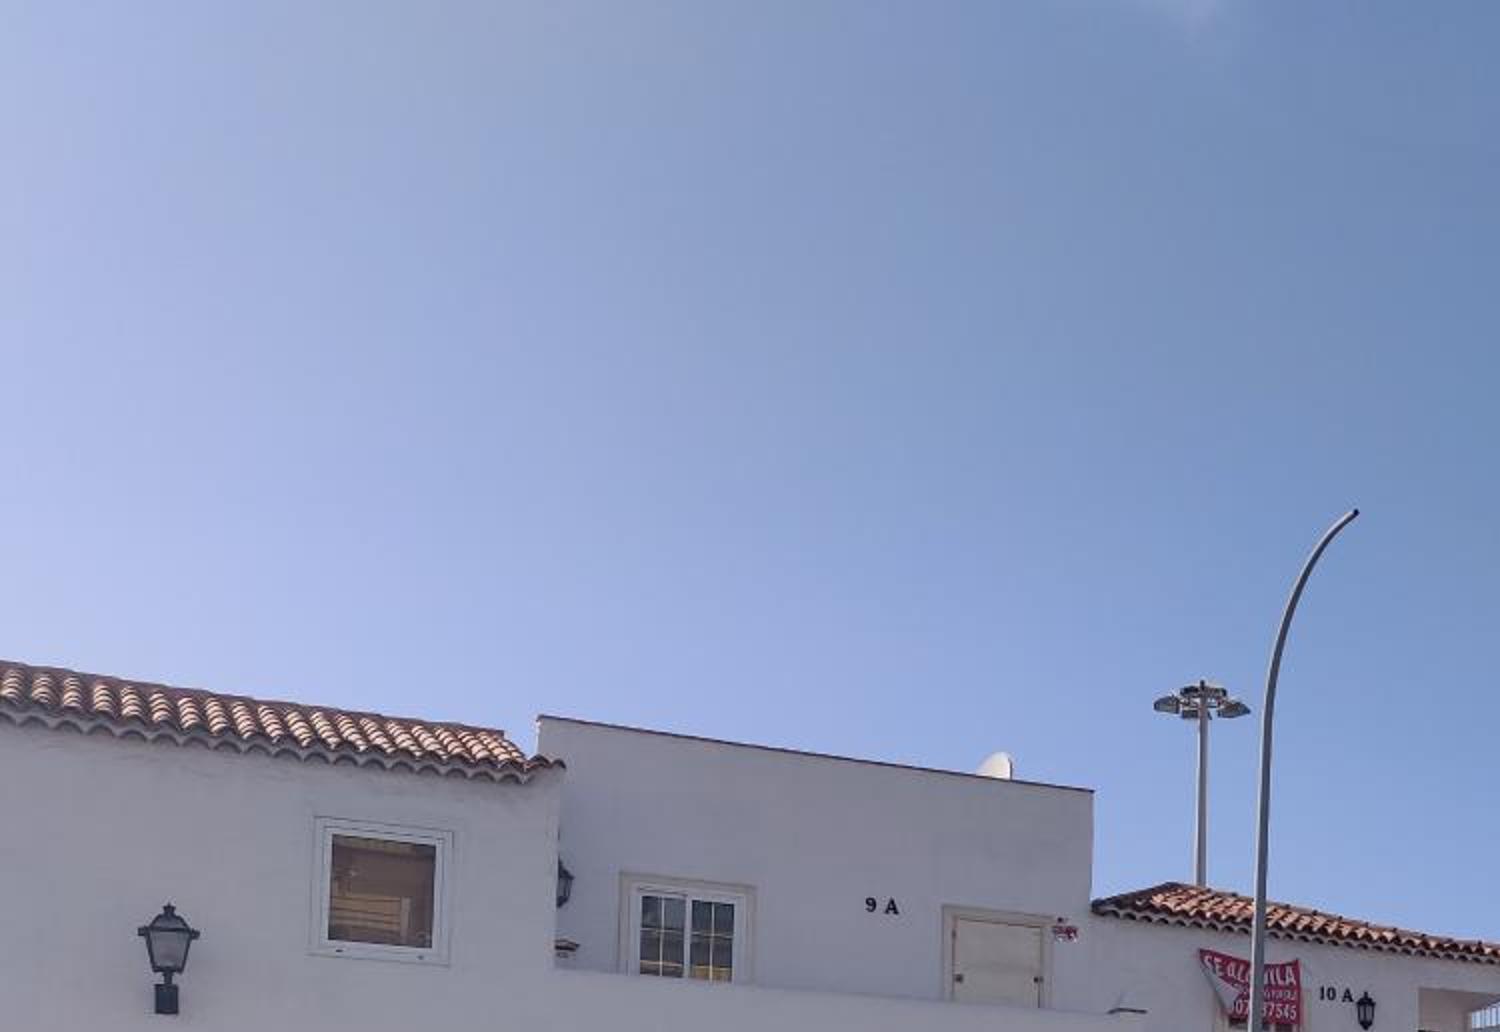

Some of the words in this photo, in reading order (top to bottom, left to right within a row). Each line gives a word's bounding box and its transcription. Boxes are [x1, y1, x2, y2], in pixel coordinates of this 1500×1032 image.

[865, 897, 877, 912] 9
[884, 899, 899, 915] A
[1227, 961, 1297, 986] ALILA
[1320, 985, 1337, 1001] 10
[1342, 988, 1354, 1002] A
